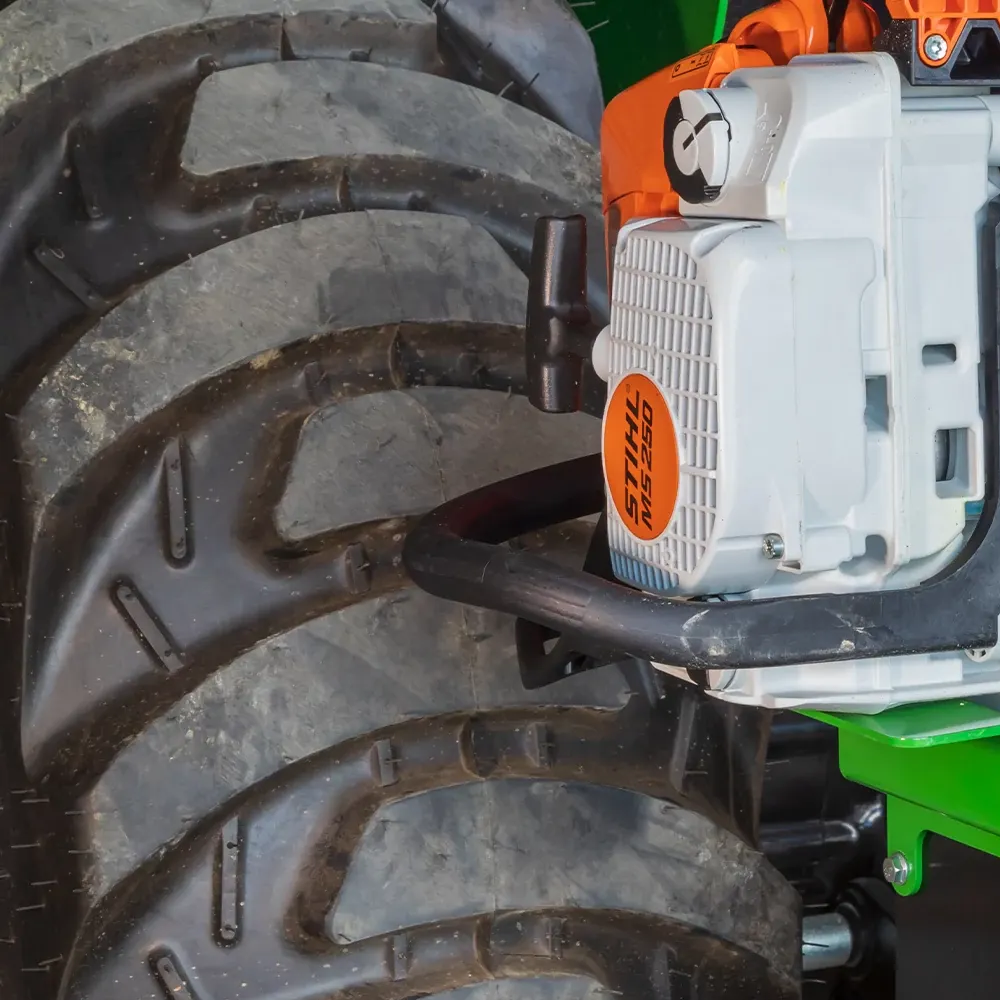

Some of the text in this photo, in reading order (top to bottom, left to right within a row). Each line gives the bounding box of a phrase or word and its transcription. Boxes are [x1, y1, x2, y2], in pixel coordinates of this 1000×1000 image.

[625, 390, 639, 526] STIHL
[641, 400, 653, 531] MS 250
